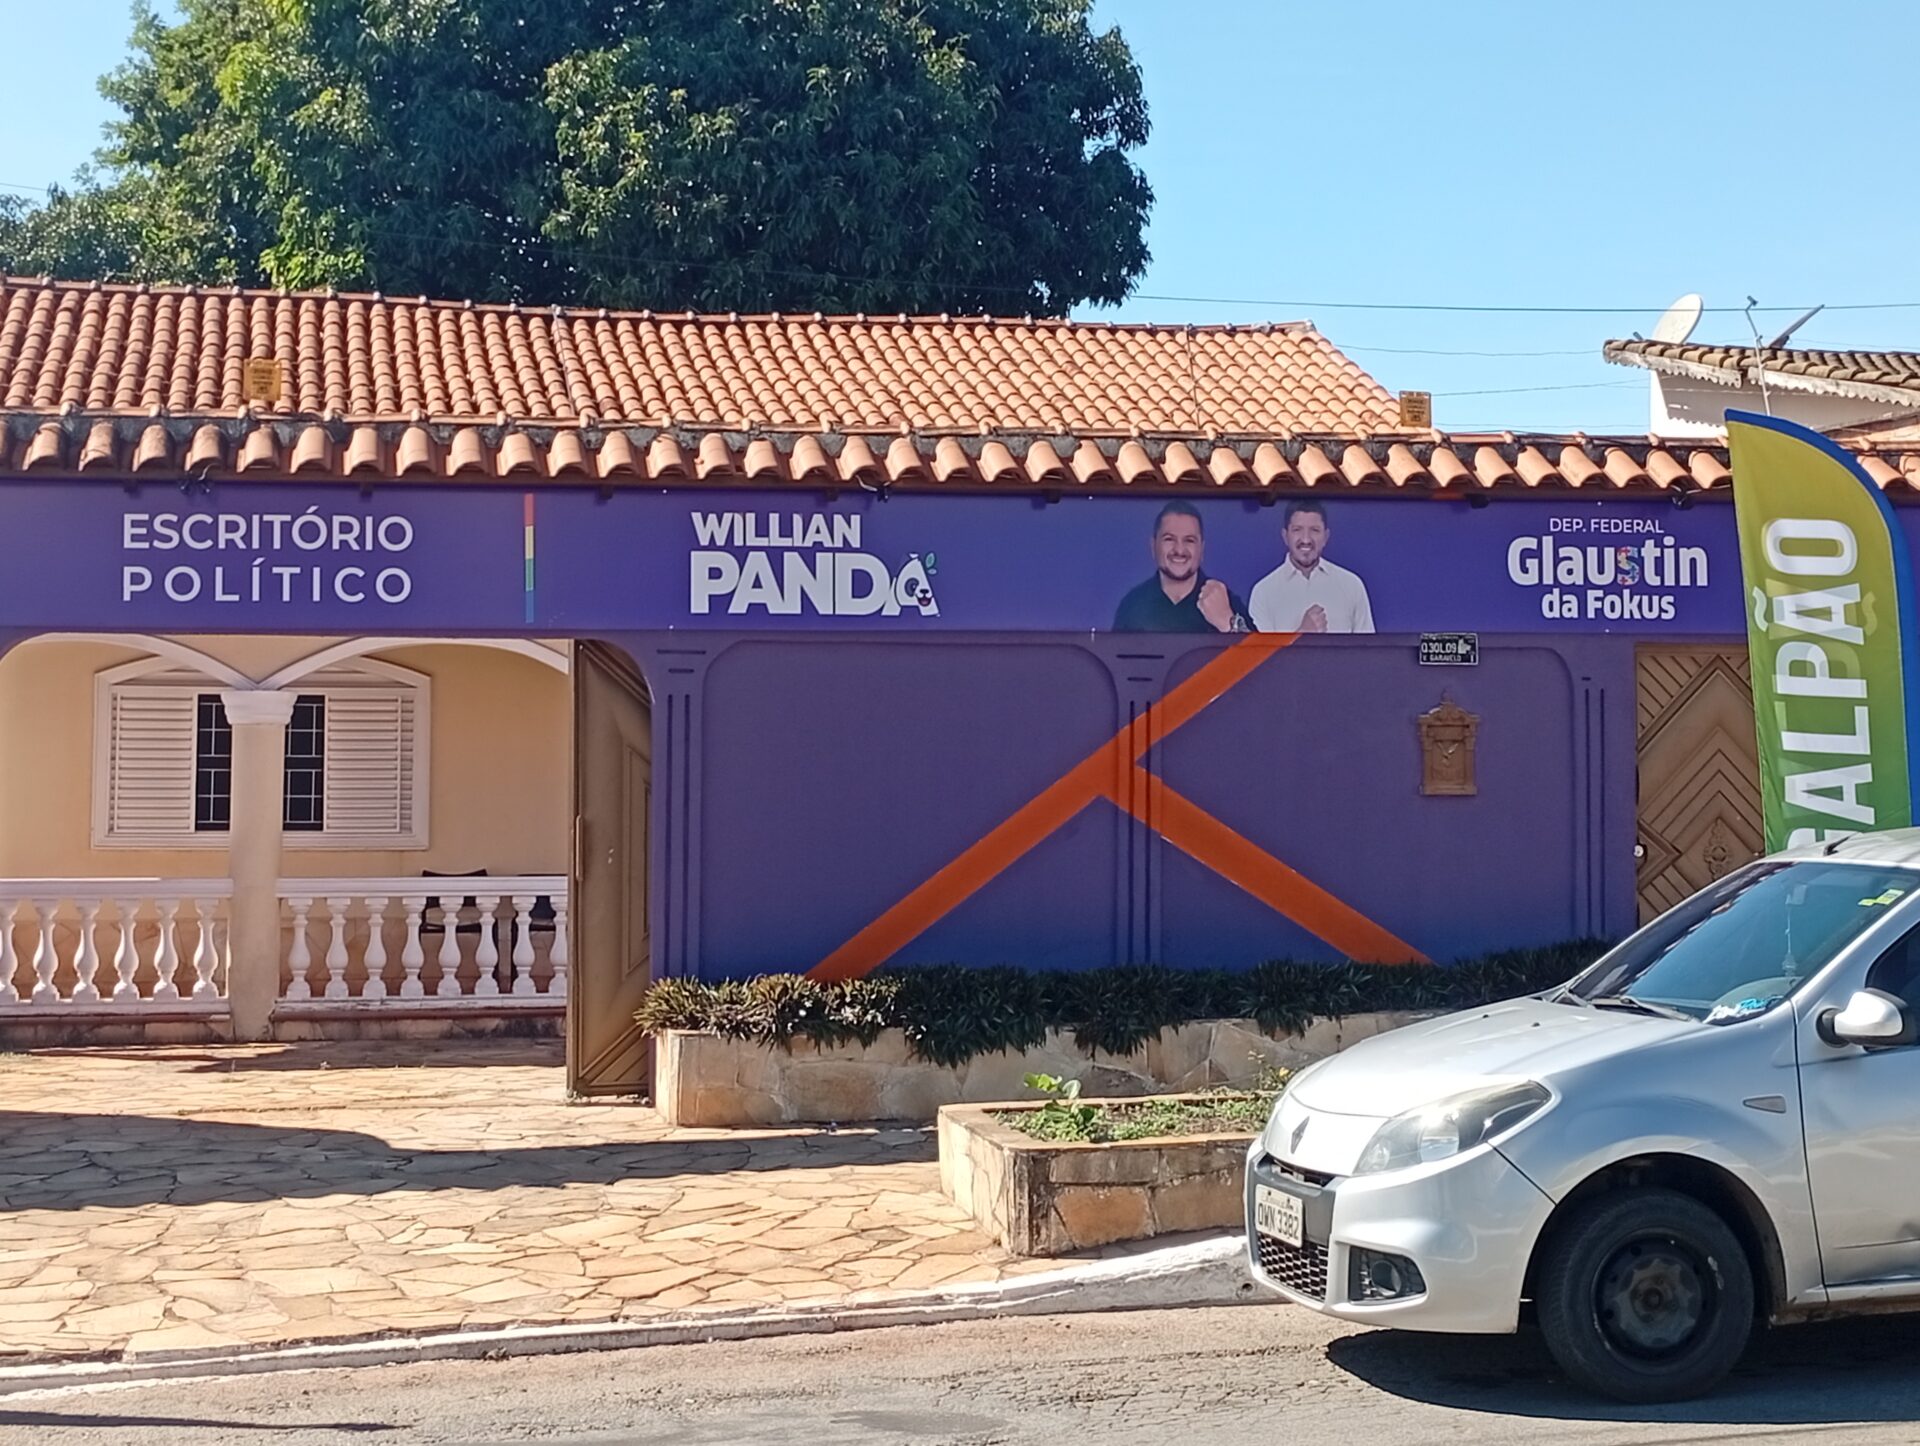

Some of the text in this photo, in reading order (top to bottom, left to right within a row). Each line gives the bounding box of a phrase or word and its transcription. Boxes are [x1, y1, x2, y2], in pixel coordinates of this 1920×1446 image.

[122, 506, 414, 551] ESCRITÓRIO
[691, 512, 861, 548] WILLIAN
[1550, 518, 1664, 533] DEP. FEDERAL
[122, 557, 412, 602] POLÍTICO
[1507, 535, 1708, 586] Glaustin
[690, 551, 940, 616] PANDA
[1542, 588, 1676, 620] da Fokus
